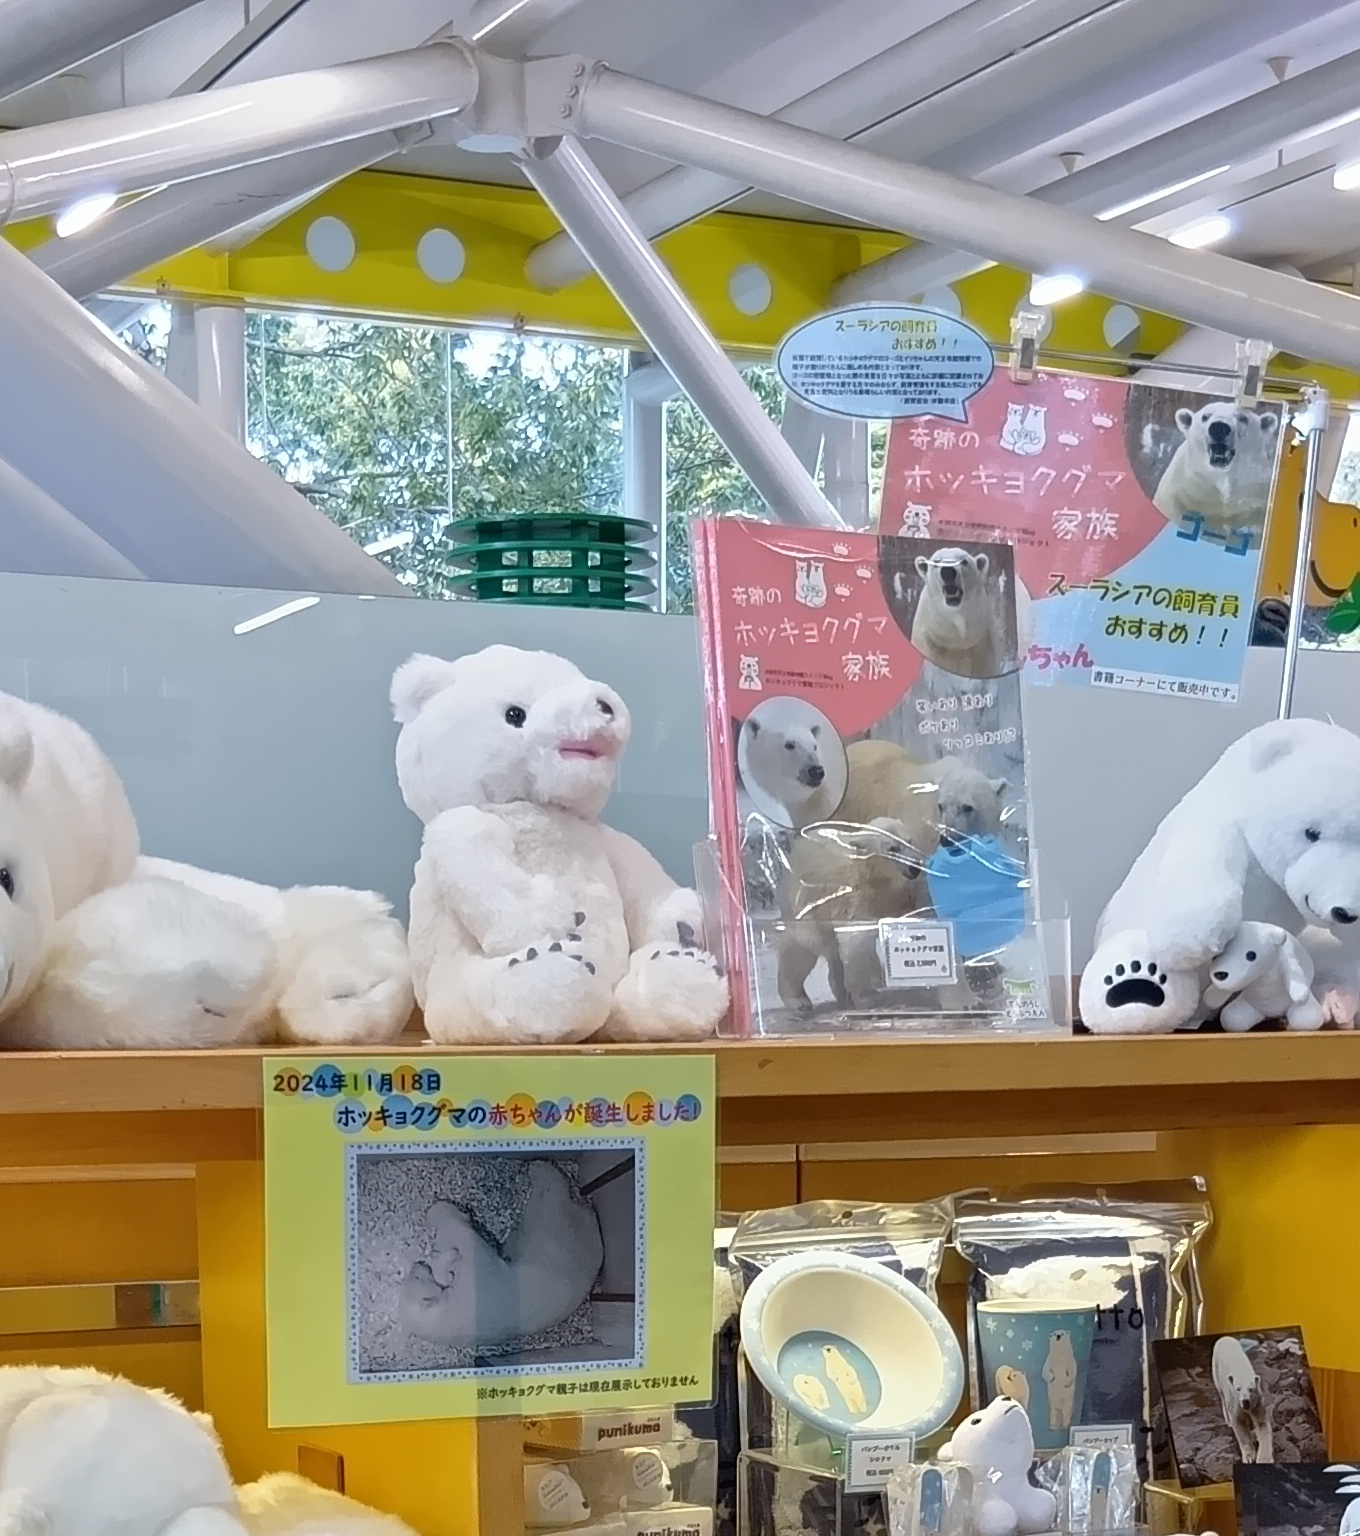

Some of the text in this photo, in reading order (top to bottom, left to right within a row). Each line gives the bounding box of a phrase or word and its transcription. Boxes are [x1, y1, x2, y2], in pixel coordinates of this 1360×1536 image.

[909, 427, 980, 451] 奇跡の
[904, 464, 1127, 498] ホッキョクグマ
[1051, 507, 1120, 540] 家族
[731, 586, 783, 607] 奇跡の
[734, 612, 889, 646] ホッキョクグマ
[841, 650, 893, 682] 家族
[1093, 671, 1237, 700] 書籍コーナーにて販売中です。
[273, 1073, 442, 1094] 2024年11月18日
[598, 1422, 661, 1441] punikuma
